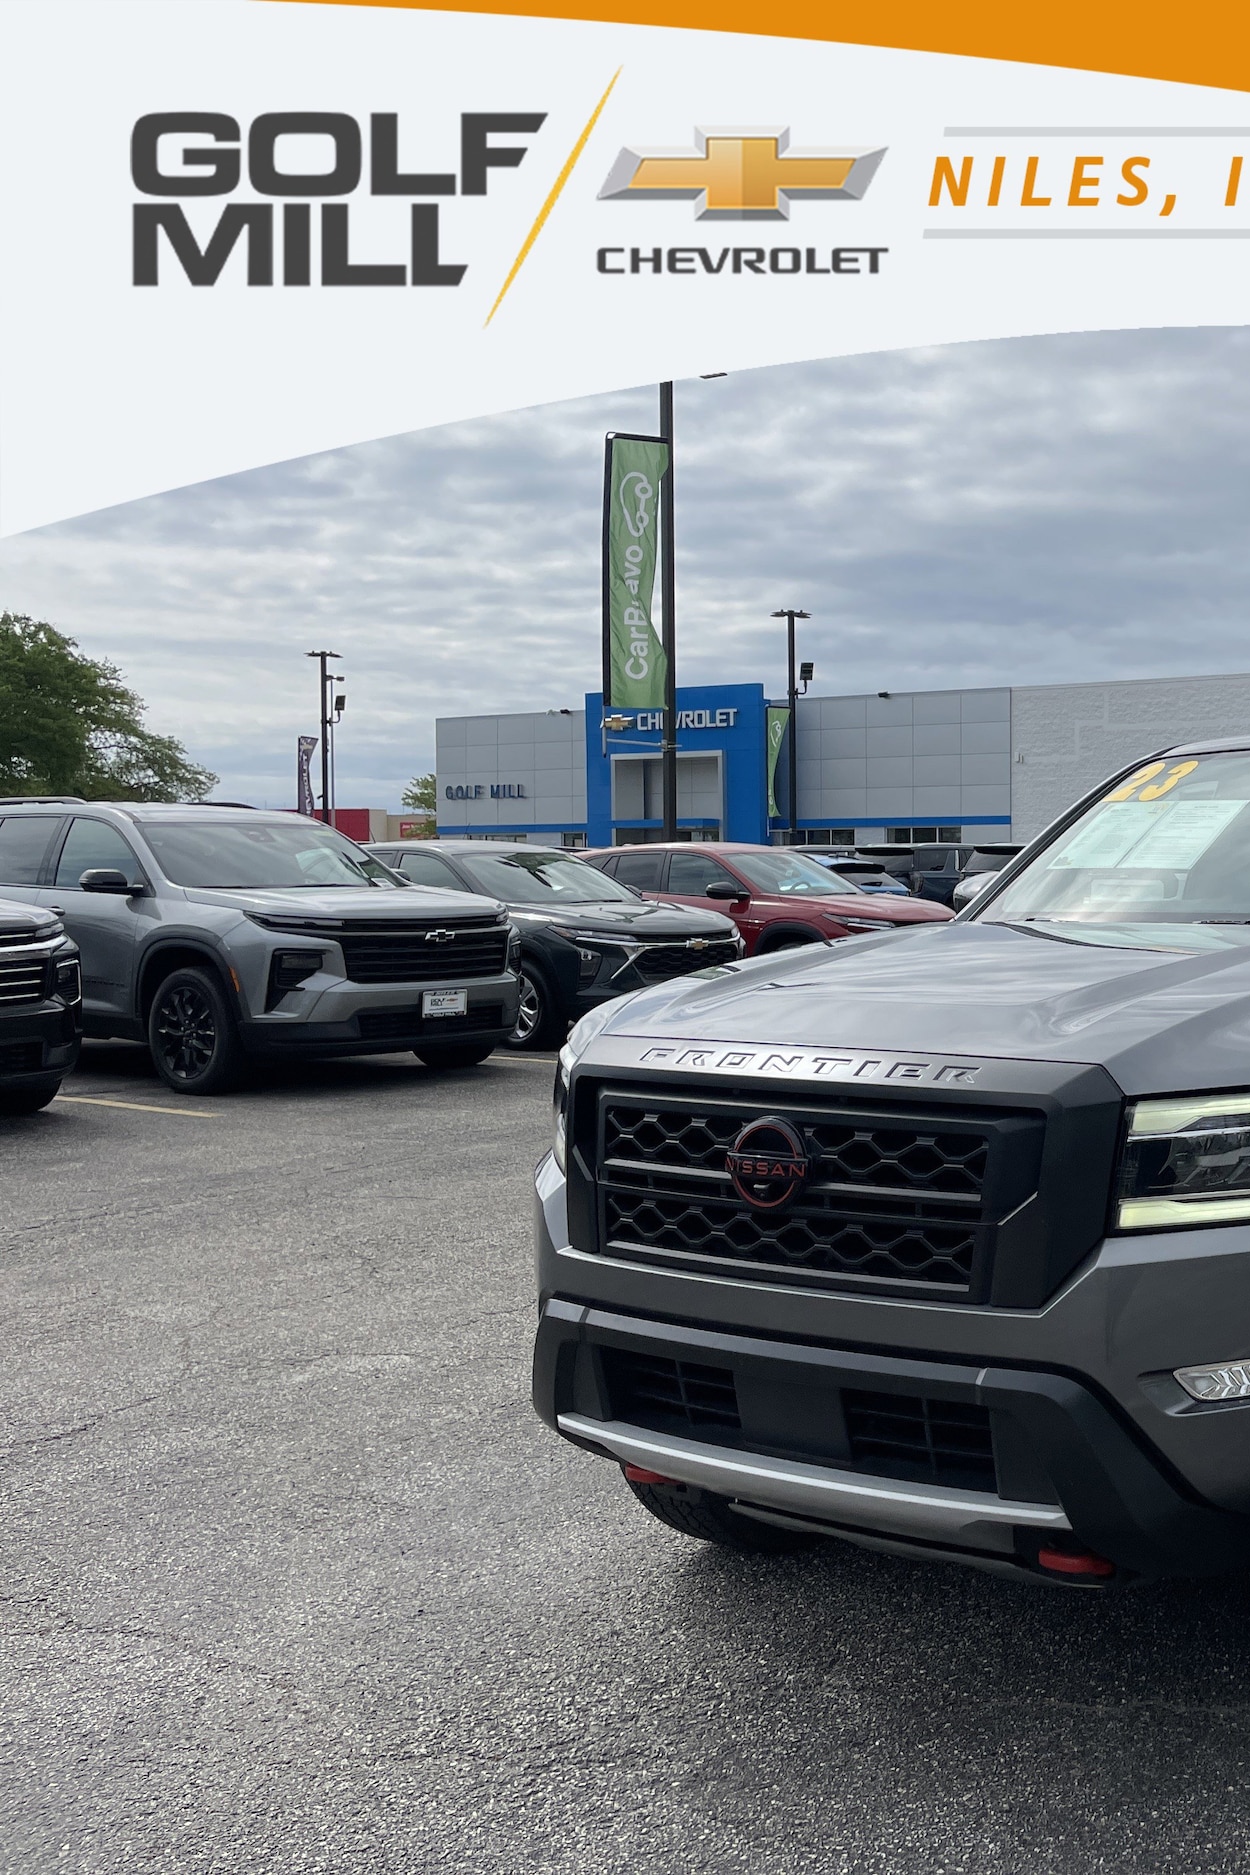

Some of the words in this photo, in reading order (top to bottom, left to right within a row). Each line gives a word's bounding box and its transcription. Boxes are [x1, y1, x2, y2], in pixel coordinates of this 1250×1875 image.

[624, 545, 649, 680] CarBavo
[637, 708, 737, 731] CHROLET
[445, 785, 484, 800] GOLF
[490, 784, 524, 799] MILL
[1101, 760, 1199, 802] 23
[639, 1047, 982, 1084] FRONTIER
[725, 1153, 805, 1178] NISSAN
